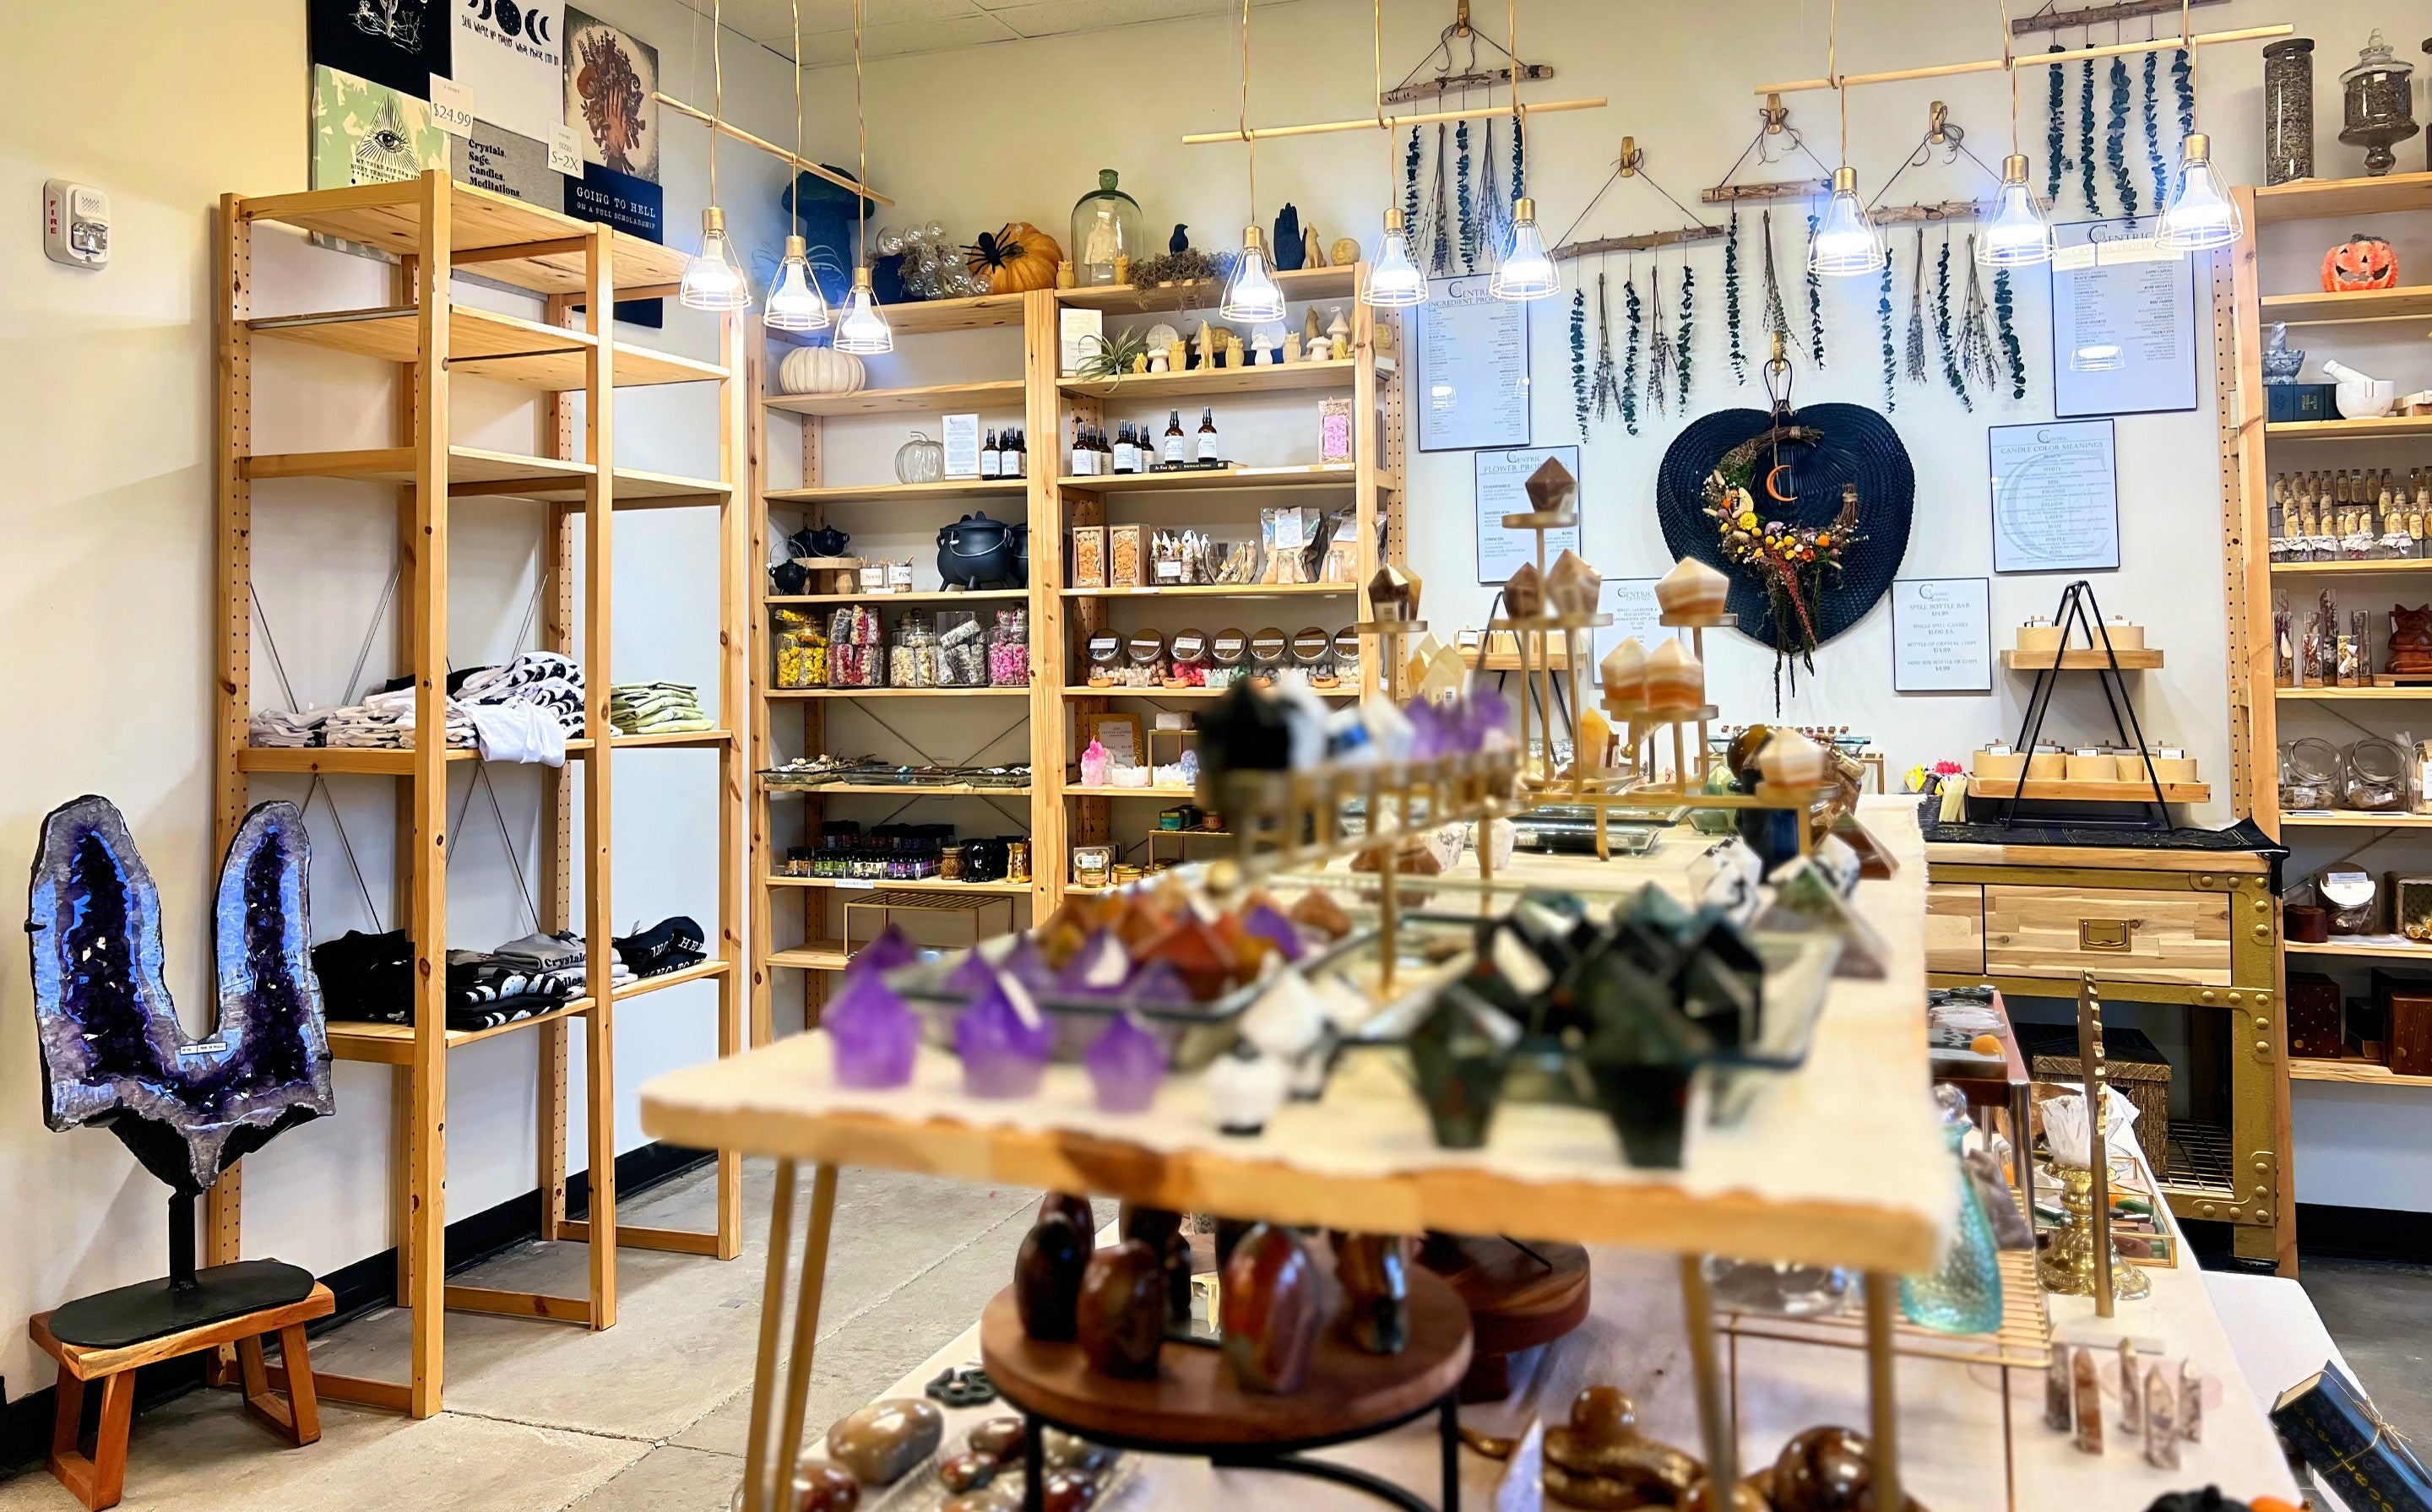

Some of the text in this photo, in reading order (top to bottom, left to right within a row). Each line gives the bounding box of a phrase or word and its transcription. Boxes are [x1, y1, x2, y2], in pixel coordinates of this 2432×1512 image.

[433, 102, 471, 127] $24.99
[468, 138, 507, 159] Crystals.
[468, 151, 491, 165] Sage.
[551, 150, 578, 171] S-2X
[366, 161, 384, 170] THIRD
[398, 170, 409, 178] CAN
[469, 164, 506, 182] Candles.
[469, 176, 522, 198] Meditations.
[577, 187, 656, 218] GOING TO HELL
[577, 202, 586, 210] ON
[595, 208, 612, 218] FULL
[613, 212, 656, 230] SCHOLARSHIP
[1447, 280, 1490, 298] CENTRI
[1428, 298, 1473, 308] INGREDIENT
[2033, 443, 2060, 453] COLOR
[2062, 442, 2104, 451] MEANINGS
[1506, 450, 1540, 463] CENTRIC
[1484, 464, 1517, 473] FLOWER
[1617, 588, 1653, 598] CENTRIC
[677, 936, 705, 951] HEL
